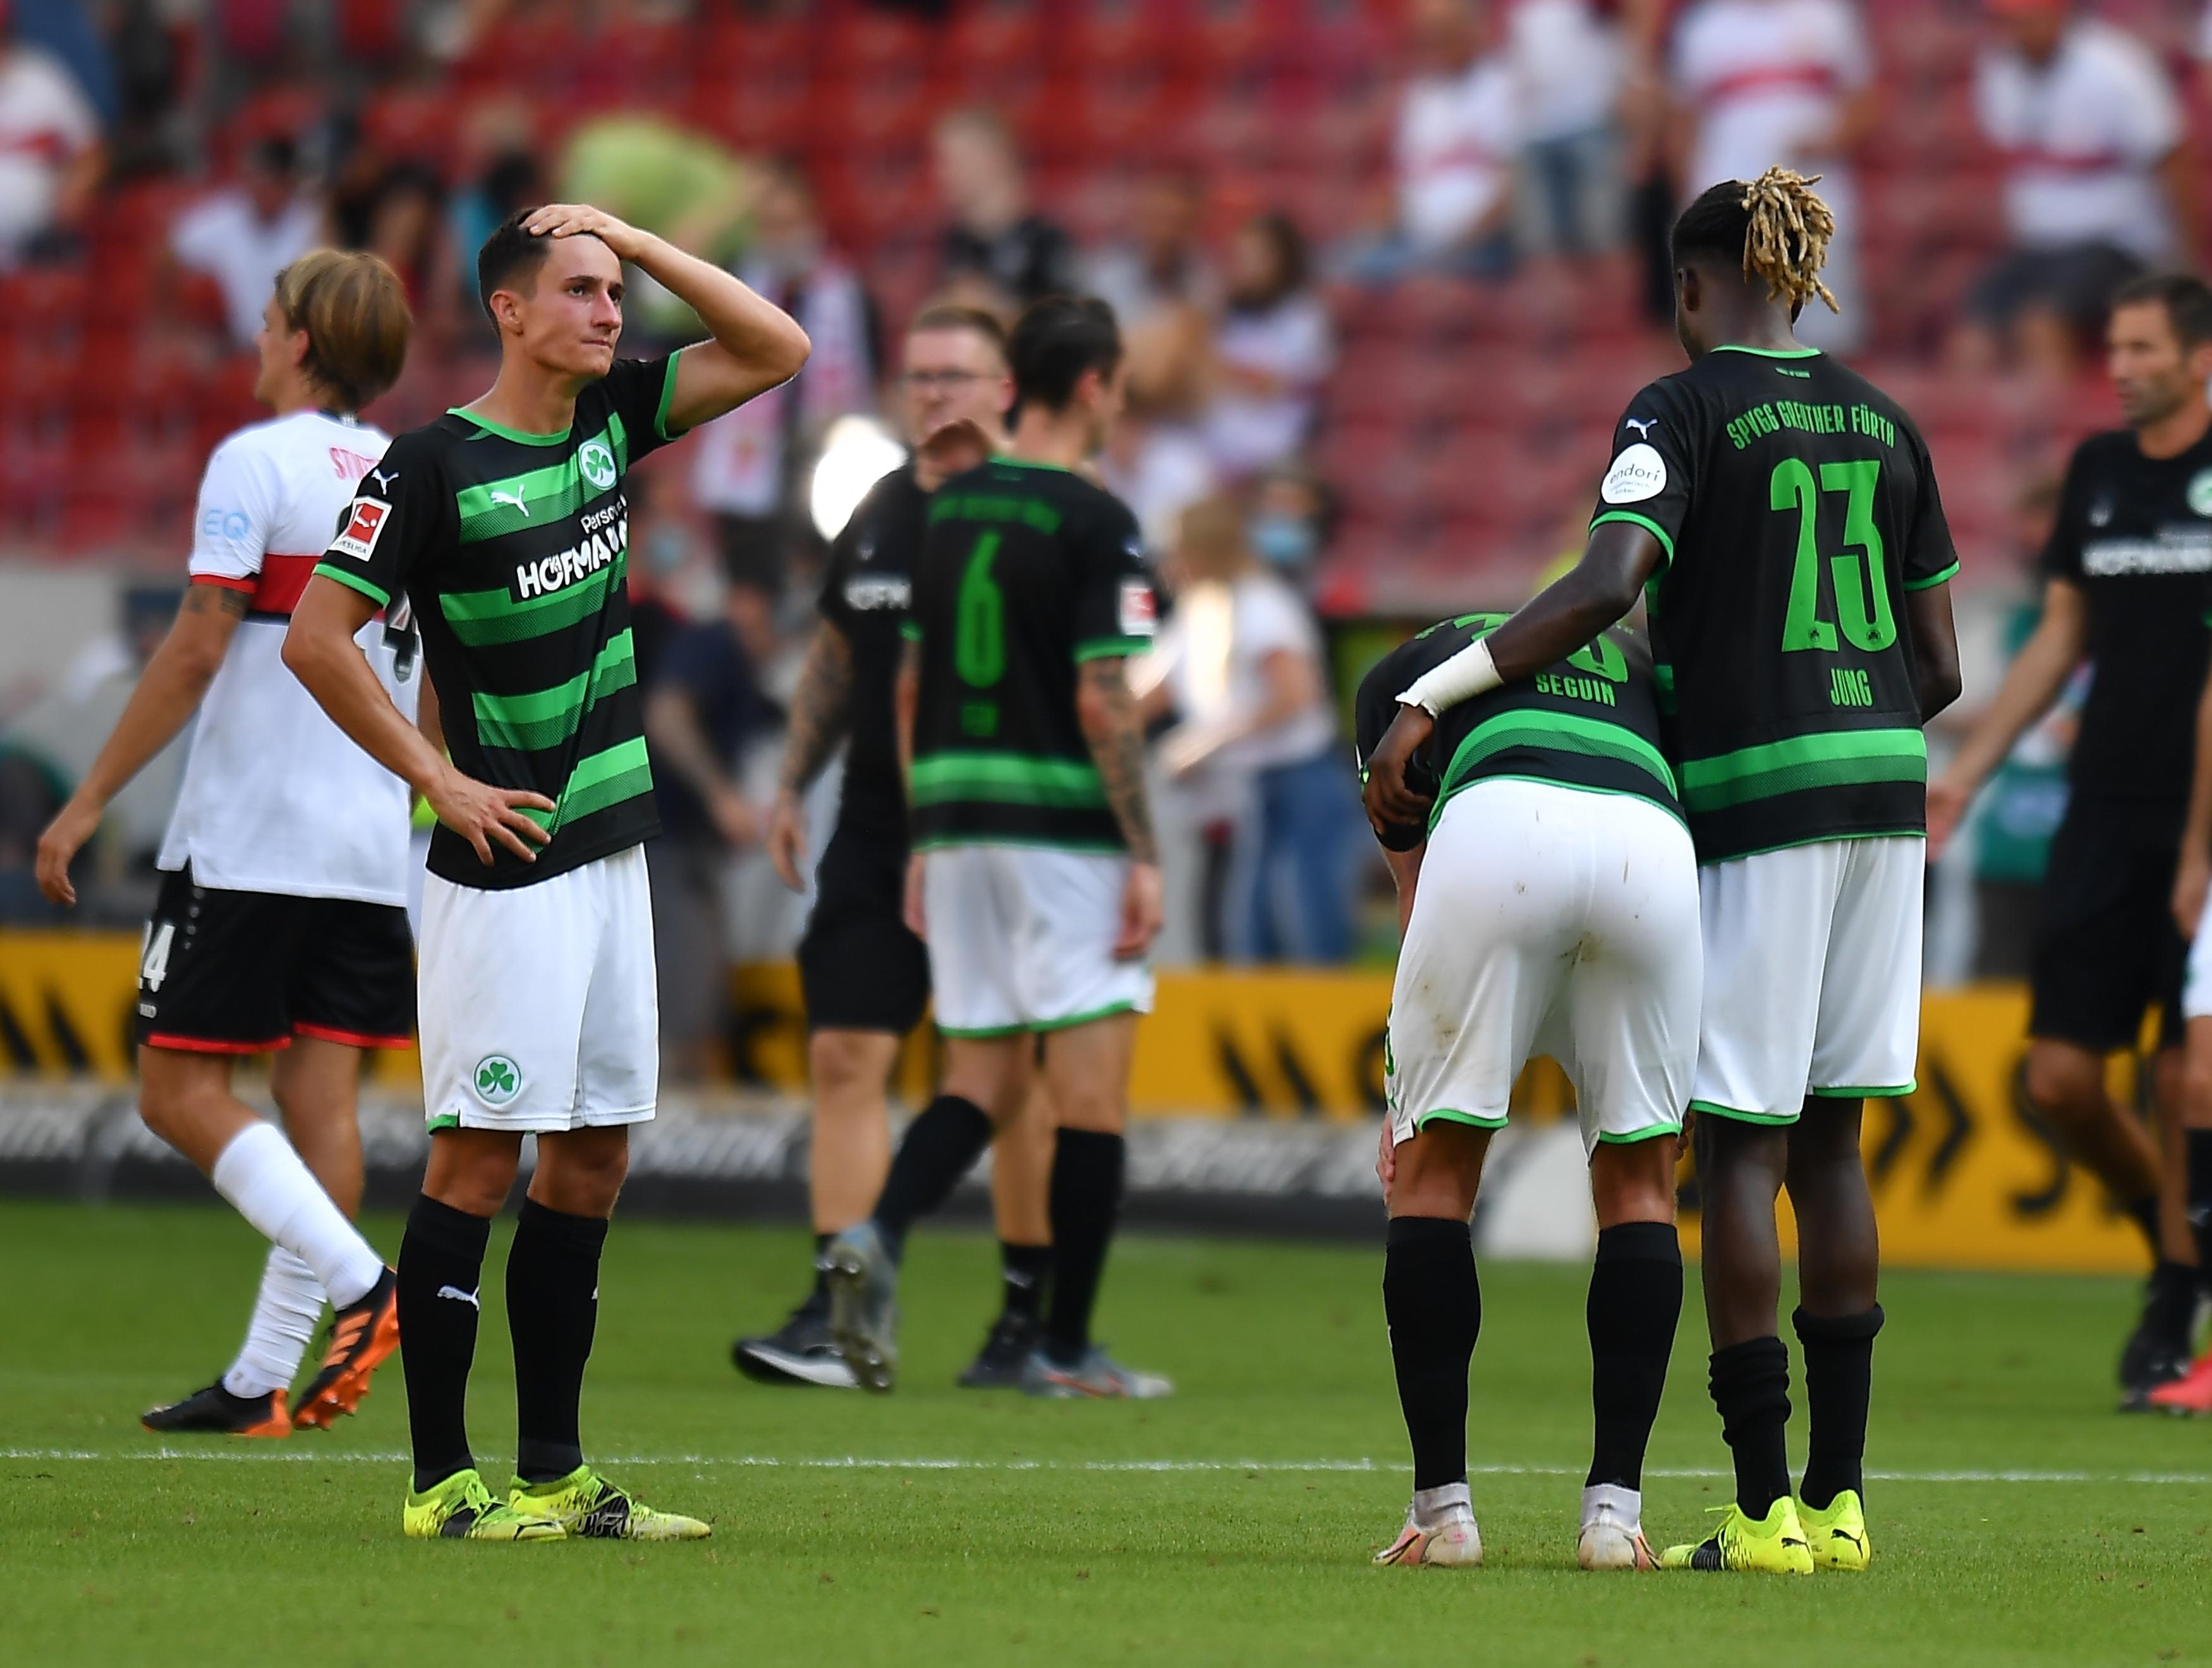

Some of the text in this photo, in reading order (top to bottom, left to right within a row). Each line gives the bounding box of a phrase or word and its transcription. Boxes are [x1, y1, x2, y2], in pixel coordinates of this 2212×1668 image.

[1850, 404, 1895, 449] FÜRTH
[203, 508, 251, 542] EQ
[1770, 458, 1897, 652] 23
[956, 529, 1006, 688] 6
[1535, 673, 1617, 707] SEGUIN
[1830, 668, 1873, 707] JUNG
